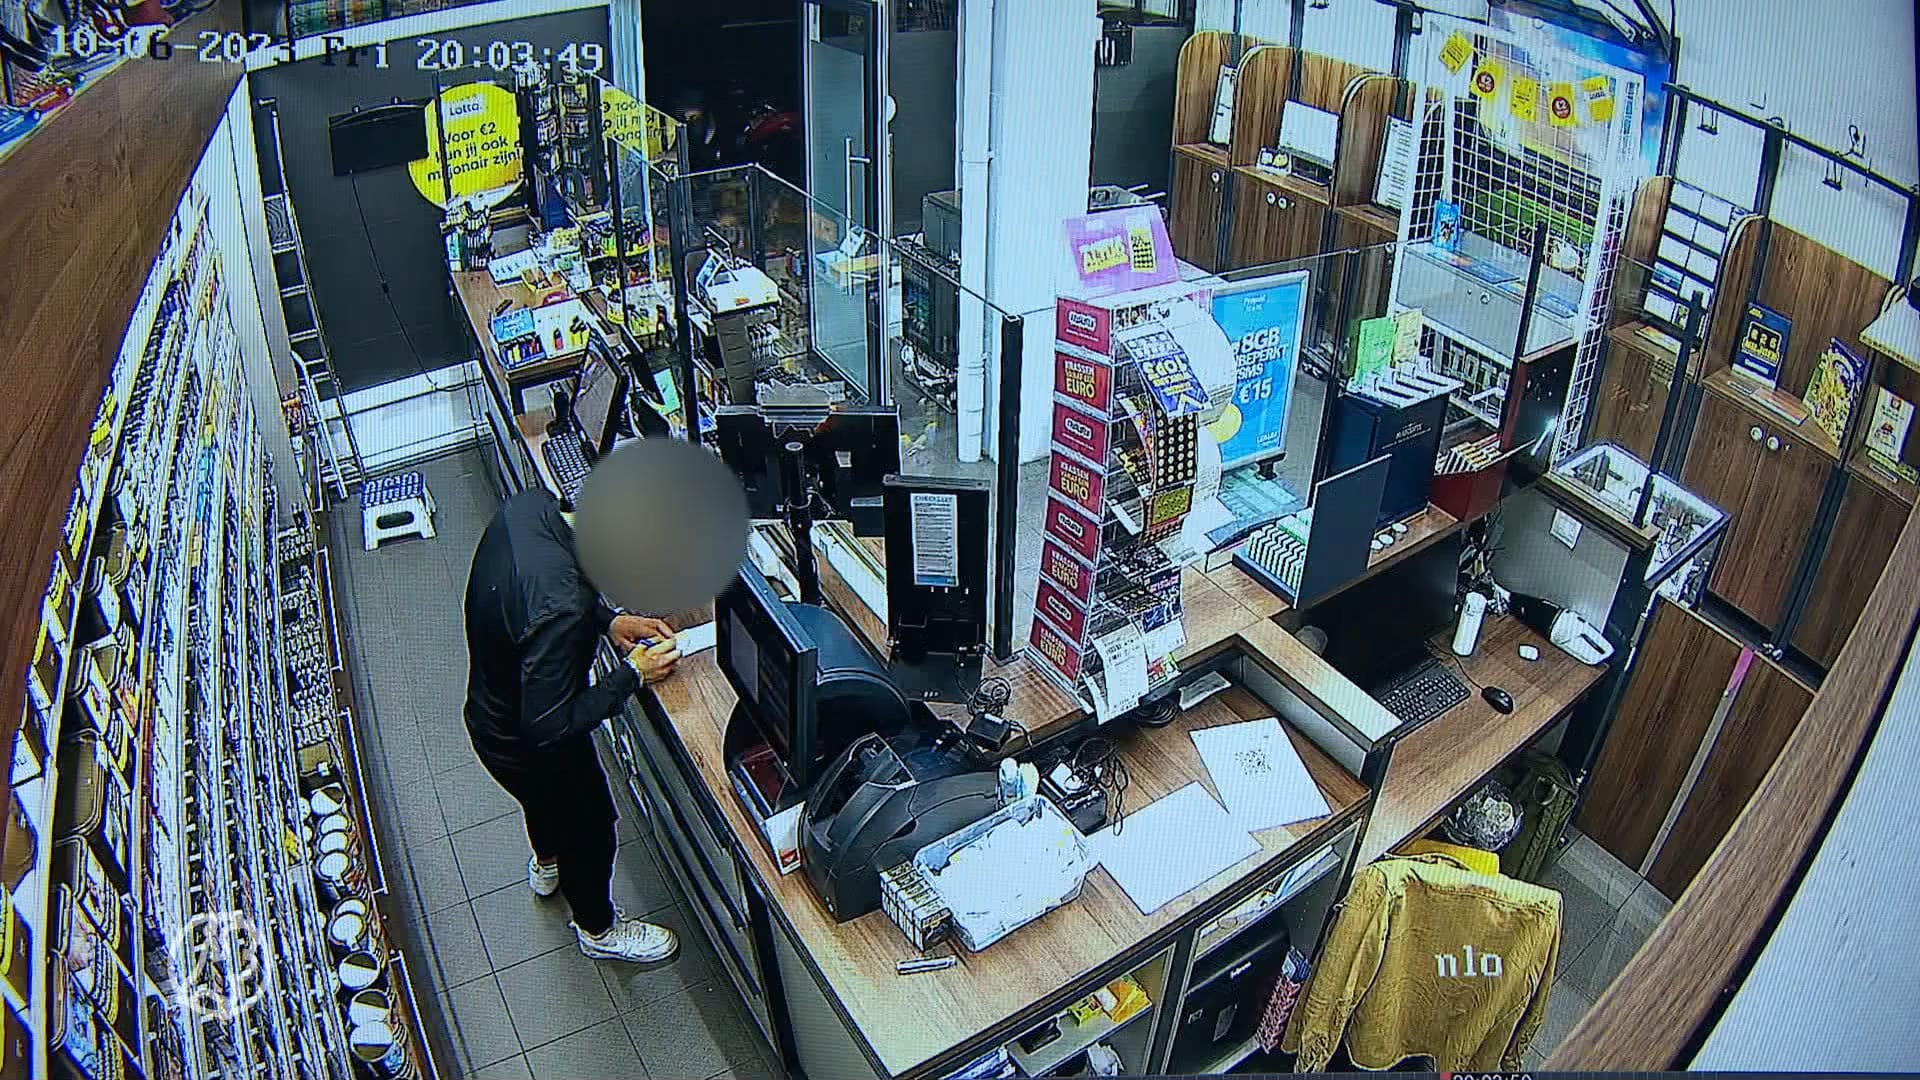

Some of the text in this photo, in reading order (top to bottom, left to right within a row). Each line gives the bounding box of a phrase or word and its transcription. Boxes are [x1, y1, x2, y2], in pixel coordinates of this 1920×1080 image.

[480, 121, 497, 136] €2
[465, 142, 478, 158] jij
[481, 136, 509, 151] ook
[492, 148, 521, 166] zijn!
[1066, 378, 1096, 399] EURO
[1239, 377, 1273, 405] €15
[1060, 478, 1089, 500] EURO
[1051, 565, 1078, 590] EURO
[1040, 640, 1066, 666] EURO
